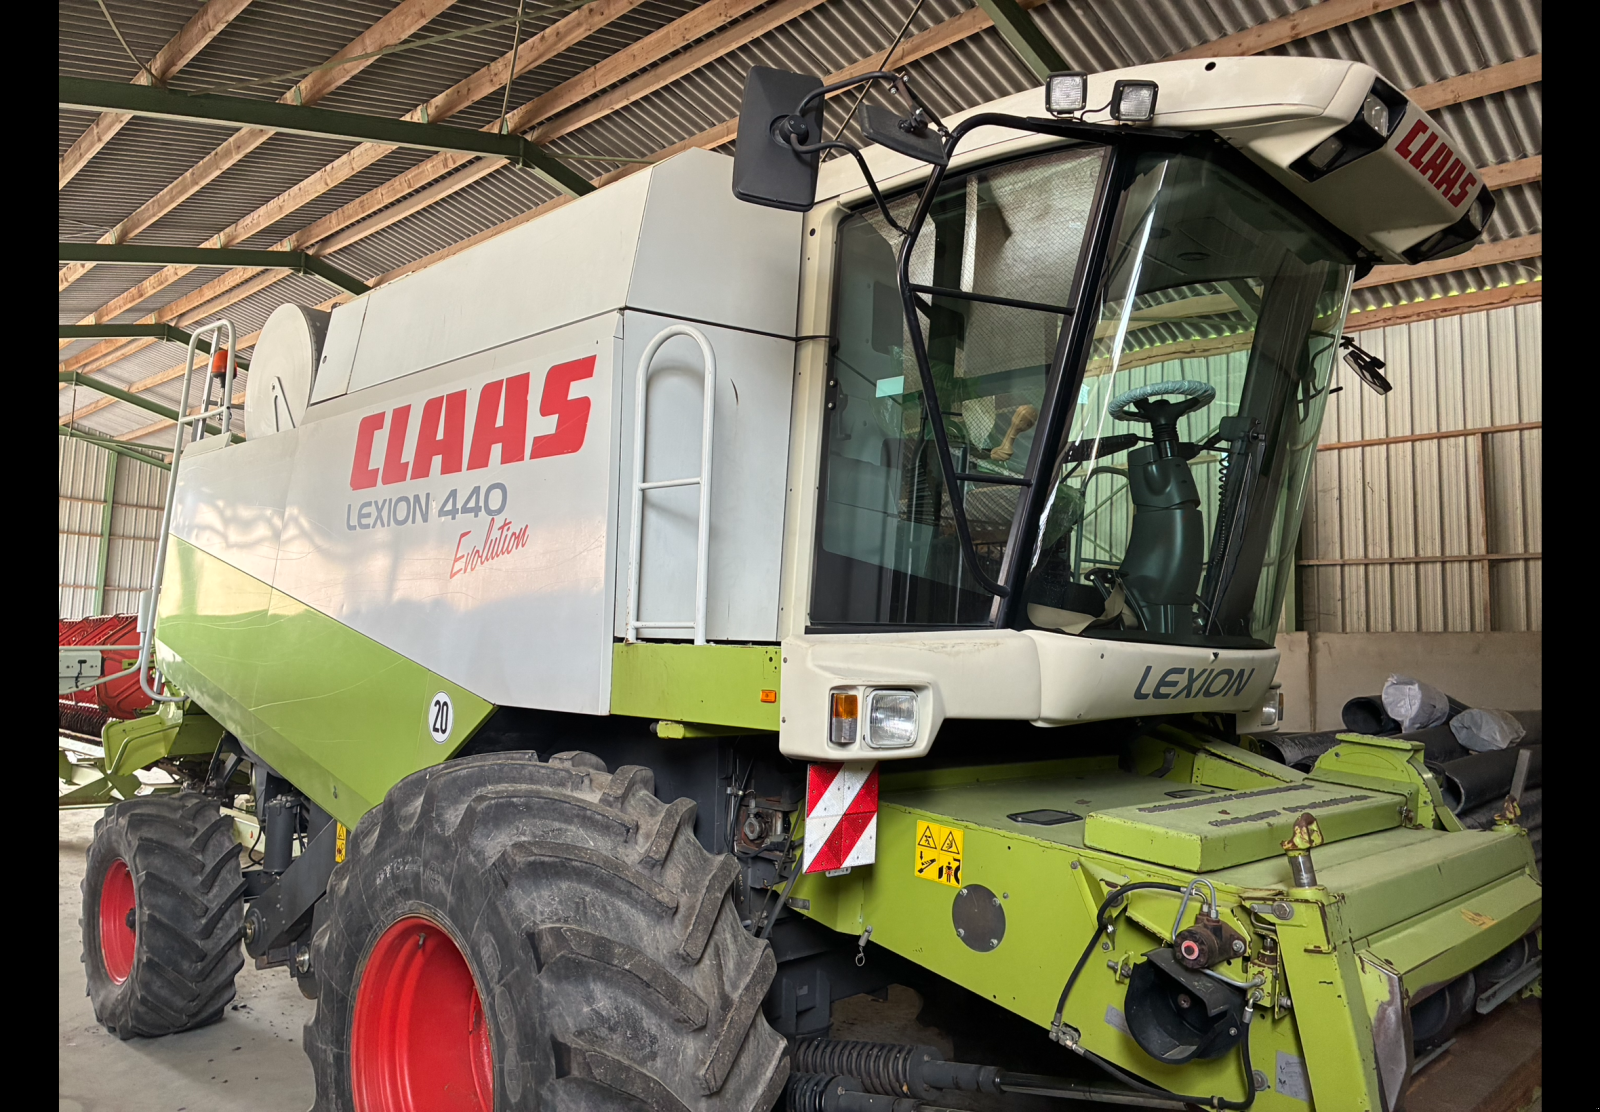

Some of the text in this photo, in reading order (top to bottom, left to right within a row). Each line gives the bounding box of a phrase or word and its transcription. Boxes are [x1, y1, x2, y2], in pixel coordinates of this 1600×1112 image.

[1394, 118, 1477, 208] CLAAS
[349, 354, 597, 491] CLAAS
[346, 482, 508, 531] LEXION 440
[449, 516, 530, 579] Evolution
[1133, 665, 1256, 700] LEXION
[432, 699, 449, 735] 20
